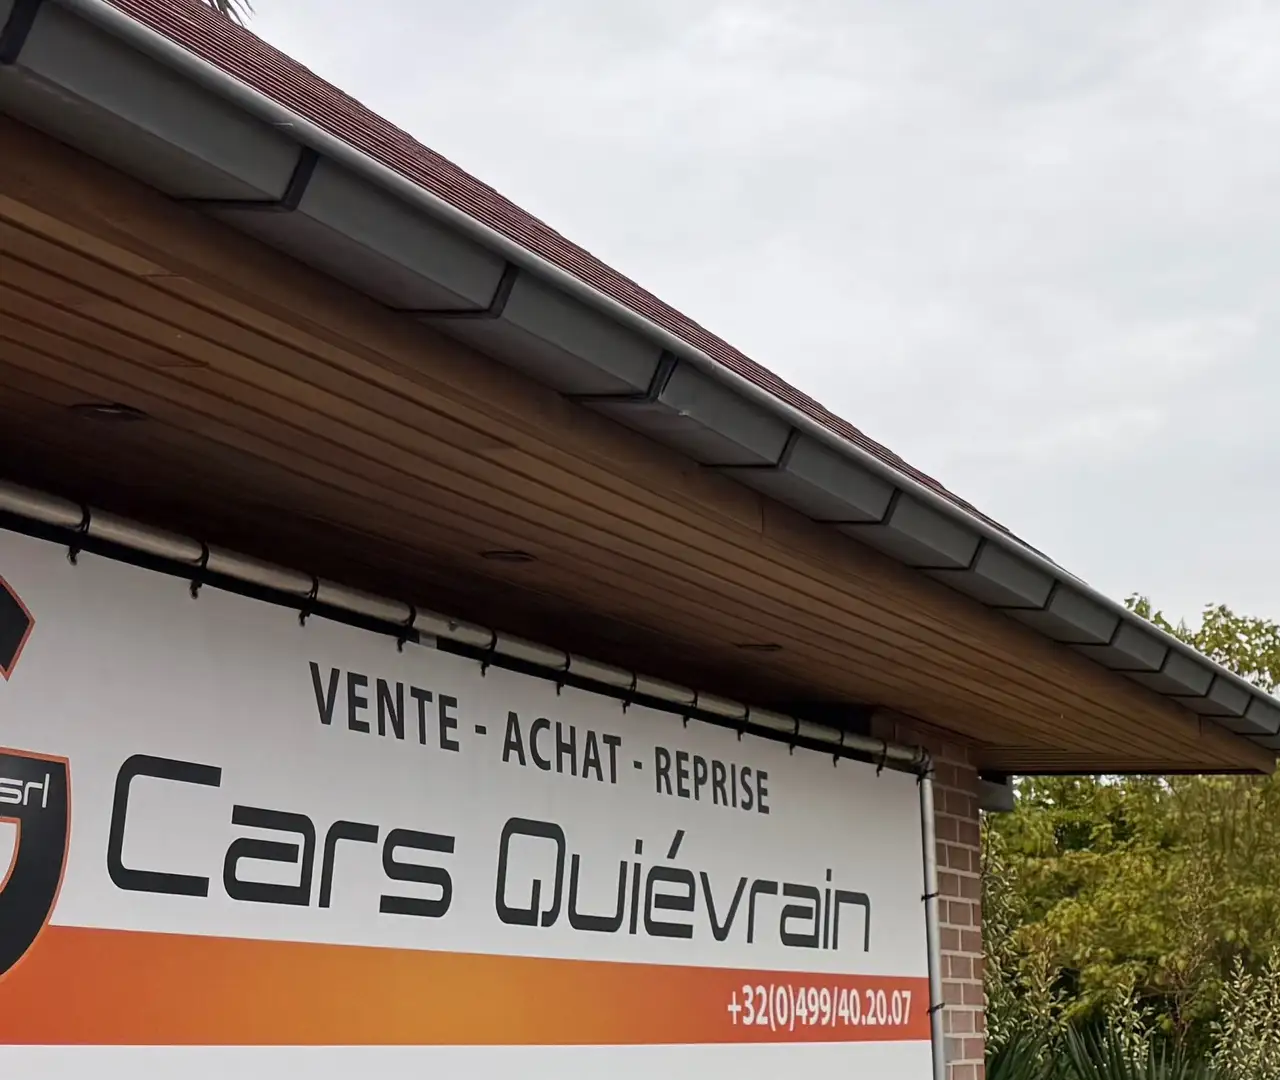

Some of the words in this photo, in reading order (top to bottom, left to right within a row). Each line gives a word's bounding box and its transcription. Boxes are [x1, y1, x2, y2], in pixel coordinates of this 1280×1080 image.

[309, 662, 460, 752] VENTE
[503, 711, 622, 784] ACHAT
[655, 747, 770, 815] REPRISE
[107, 755, 456, 917] Cars
[496, 818, 870, 951] Quiévrain
[727, 984, 911, 1032] +32(0)499/40.20.07
